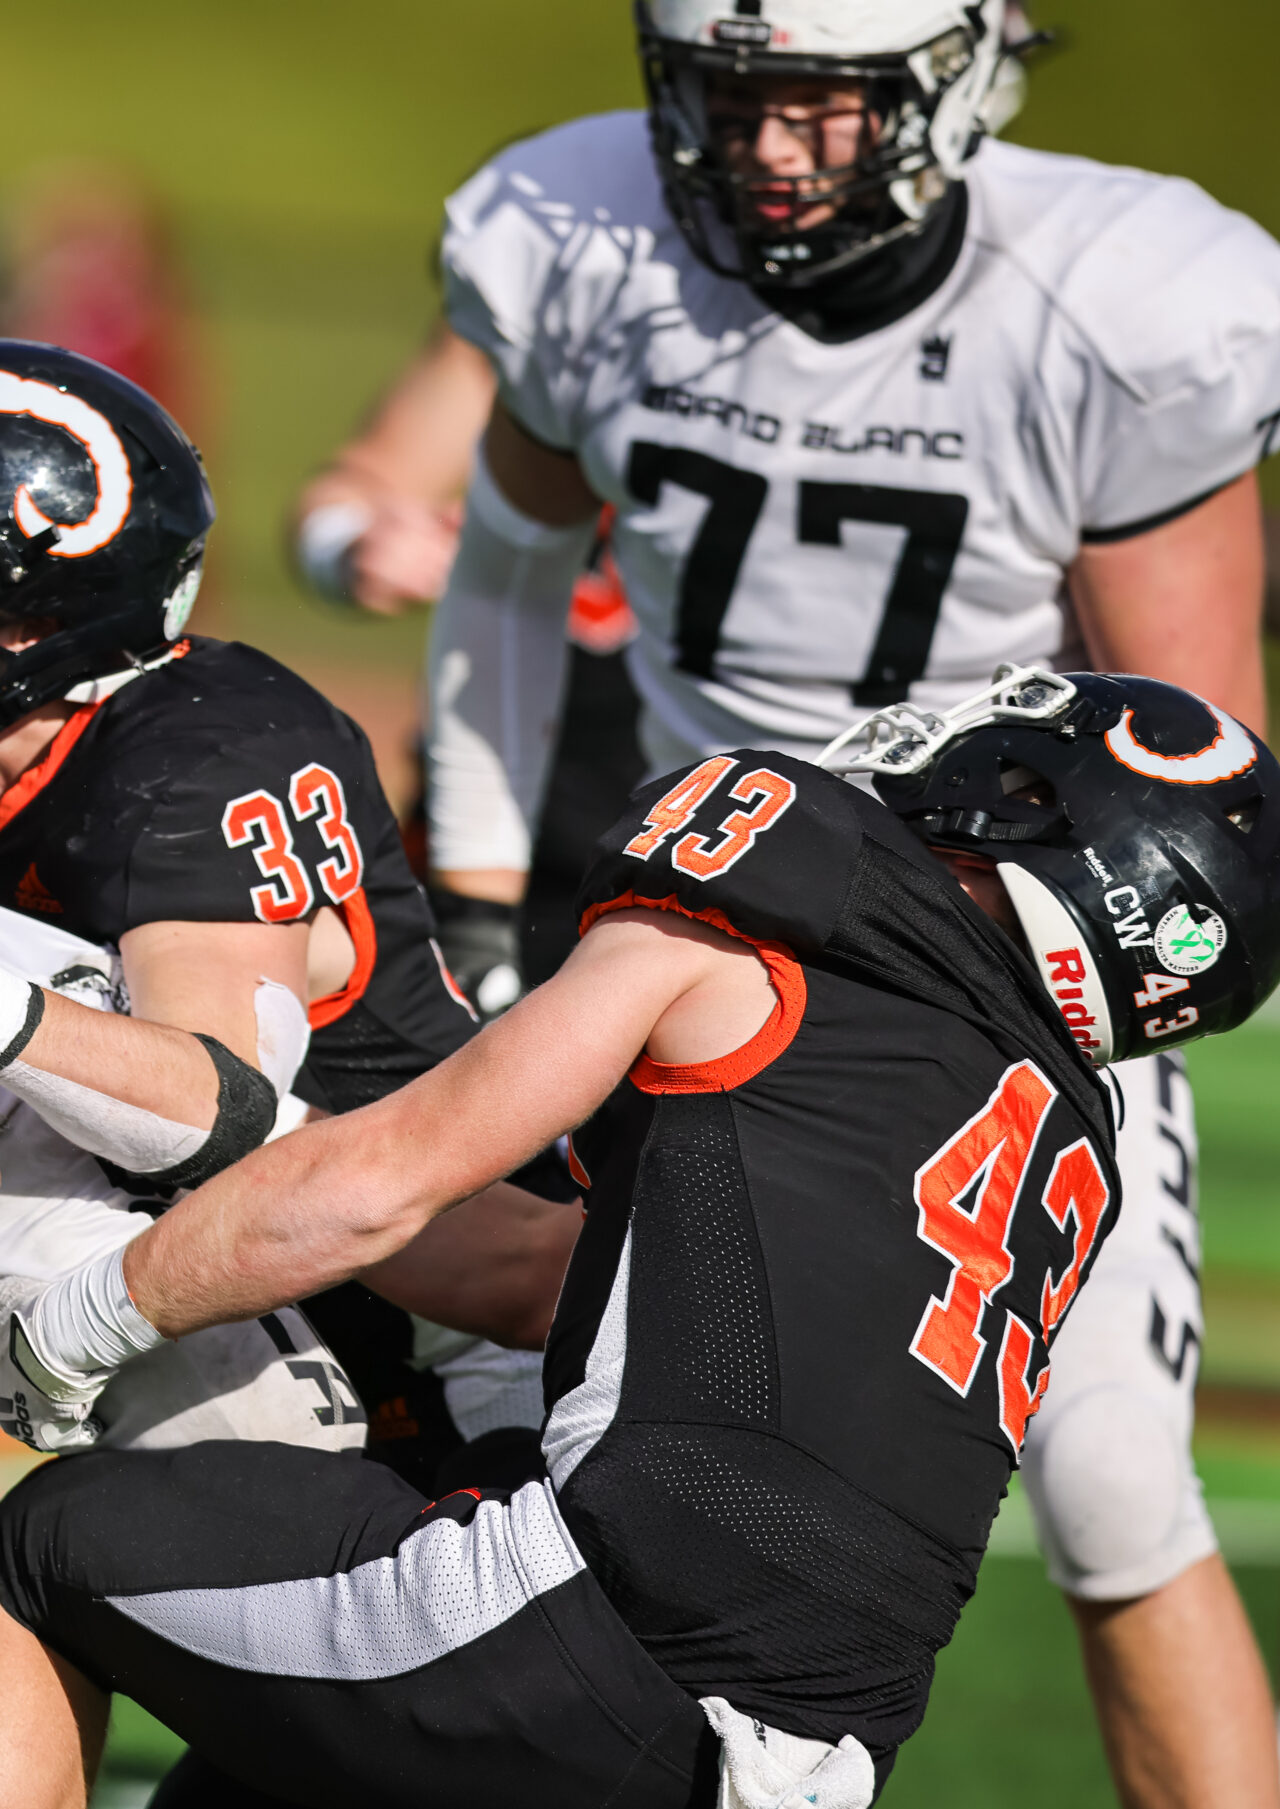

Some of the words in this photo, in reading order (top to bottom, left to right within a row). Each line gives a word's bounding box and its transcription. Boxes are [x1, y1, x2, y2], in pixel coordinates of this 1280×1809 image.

[801, 420, 964, 459] BLANC
[627, 440, 970, 706] 77
[222, 761, 364, 924] 33
[622, 755, 796, 882] 43
[1104, 885, 1154, 950] CW
[1133, 972, 1200, 1039] 43
[909, 1058, 1110, 1452] 43
